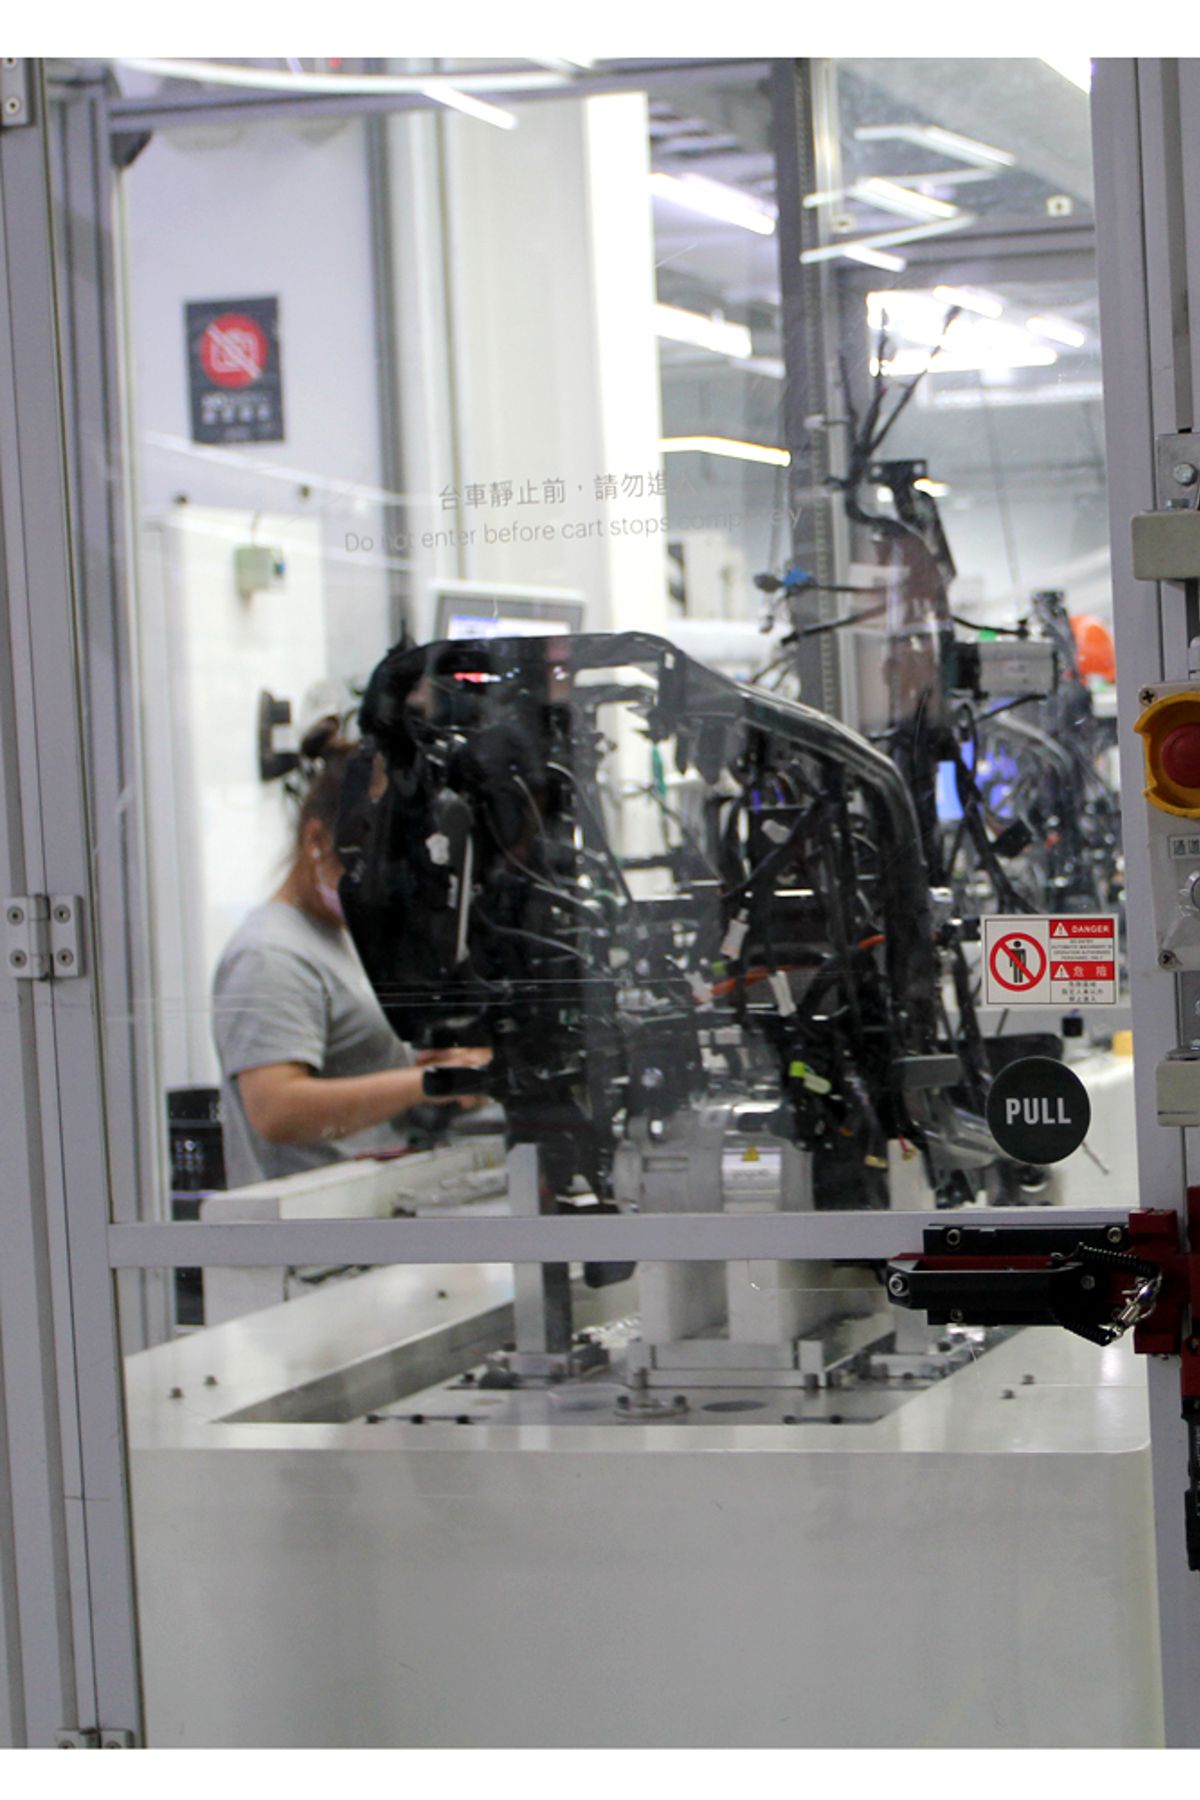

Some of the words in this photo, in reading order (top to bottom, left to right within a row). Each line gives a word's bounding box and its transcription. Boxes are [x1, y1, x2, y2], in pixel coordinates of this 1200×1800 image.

[344, 532, 374, 552] Do
[421, 528, 477, 549] enter
[484, 519, 556, 545] before
[561, 518, 604, 540] cart
[610, 517, 669, 538] stops
[1071, 924, 1110, 934] DANGER
[1005, 1097, 1072, 1126] PULL
